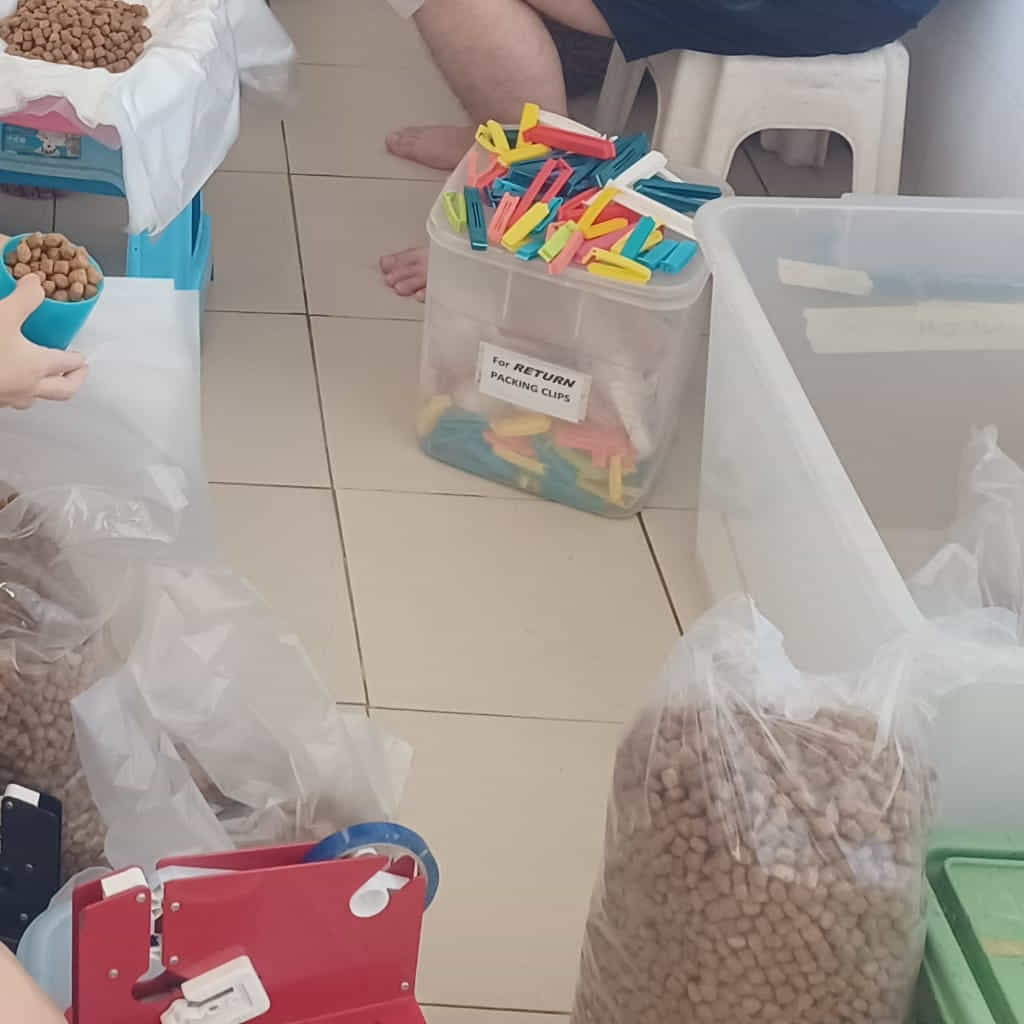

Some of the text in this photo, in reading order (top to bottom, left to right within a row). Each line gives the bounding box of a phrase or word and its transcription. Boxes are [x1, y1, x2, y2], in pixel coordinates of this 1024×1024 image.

[490, 371, 572, 403] PACKING CLIPS
[492, 356, 577, 389] For RETURN
